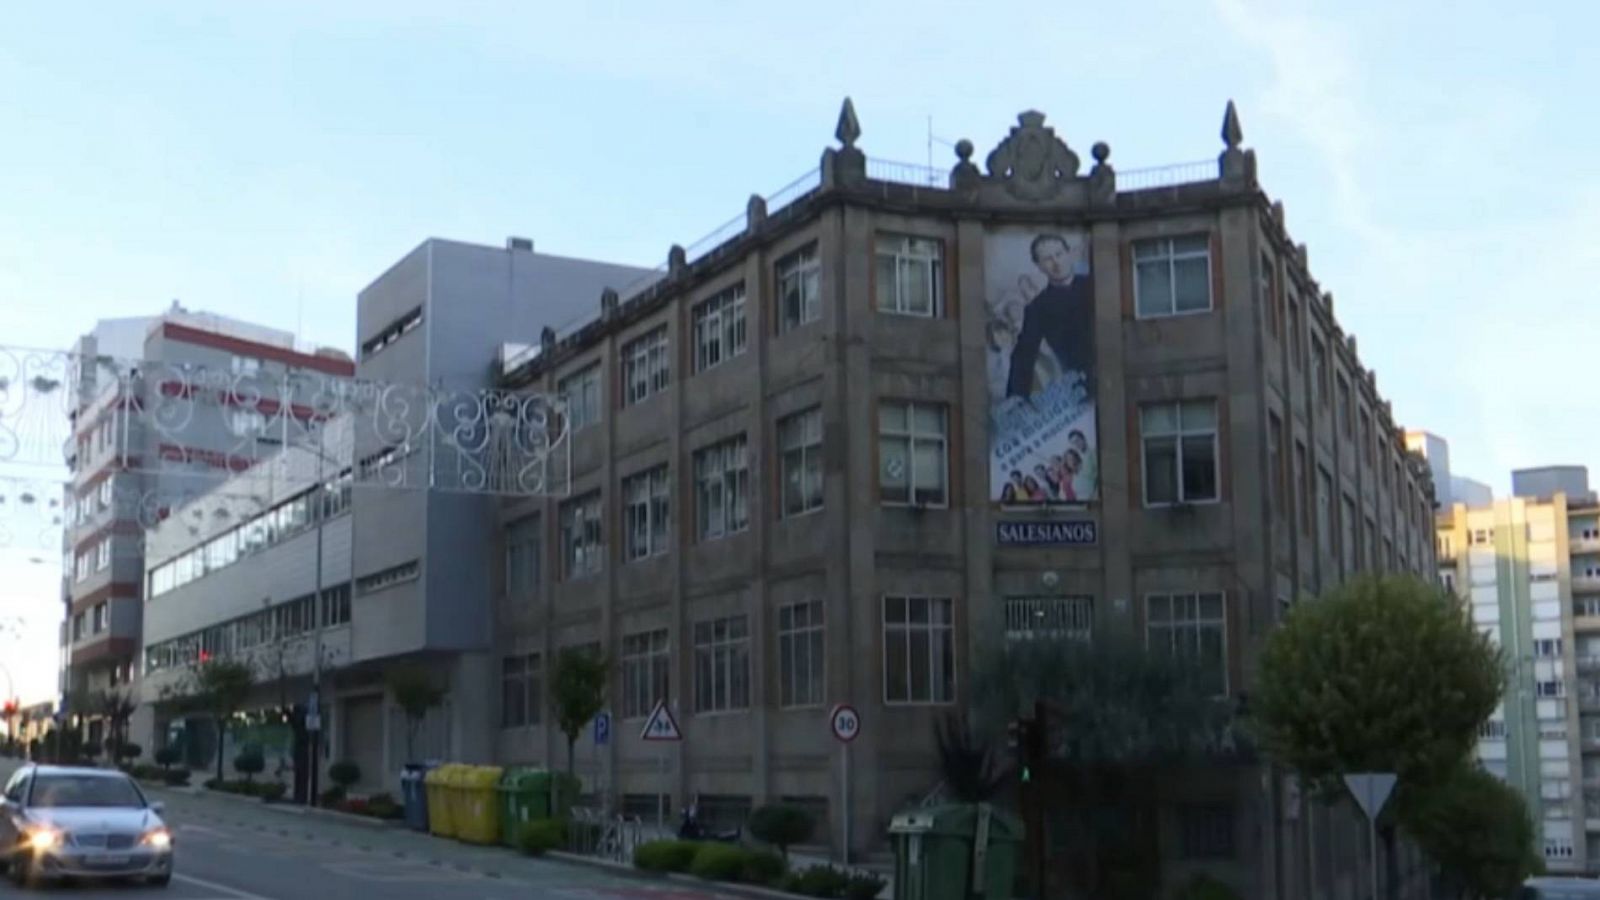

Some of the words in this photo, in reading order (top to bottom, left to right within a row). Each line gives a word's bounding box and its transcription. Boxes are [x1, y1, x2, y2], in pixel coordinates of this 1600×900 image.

[1000, 524, 1094, 541] SALESIANOS
[597, 716, 606, 741] P
[839, 716, 854, 731] 30
